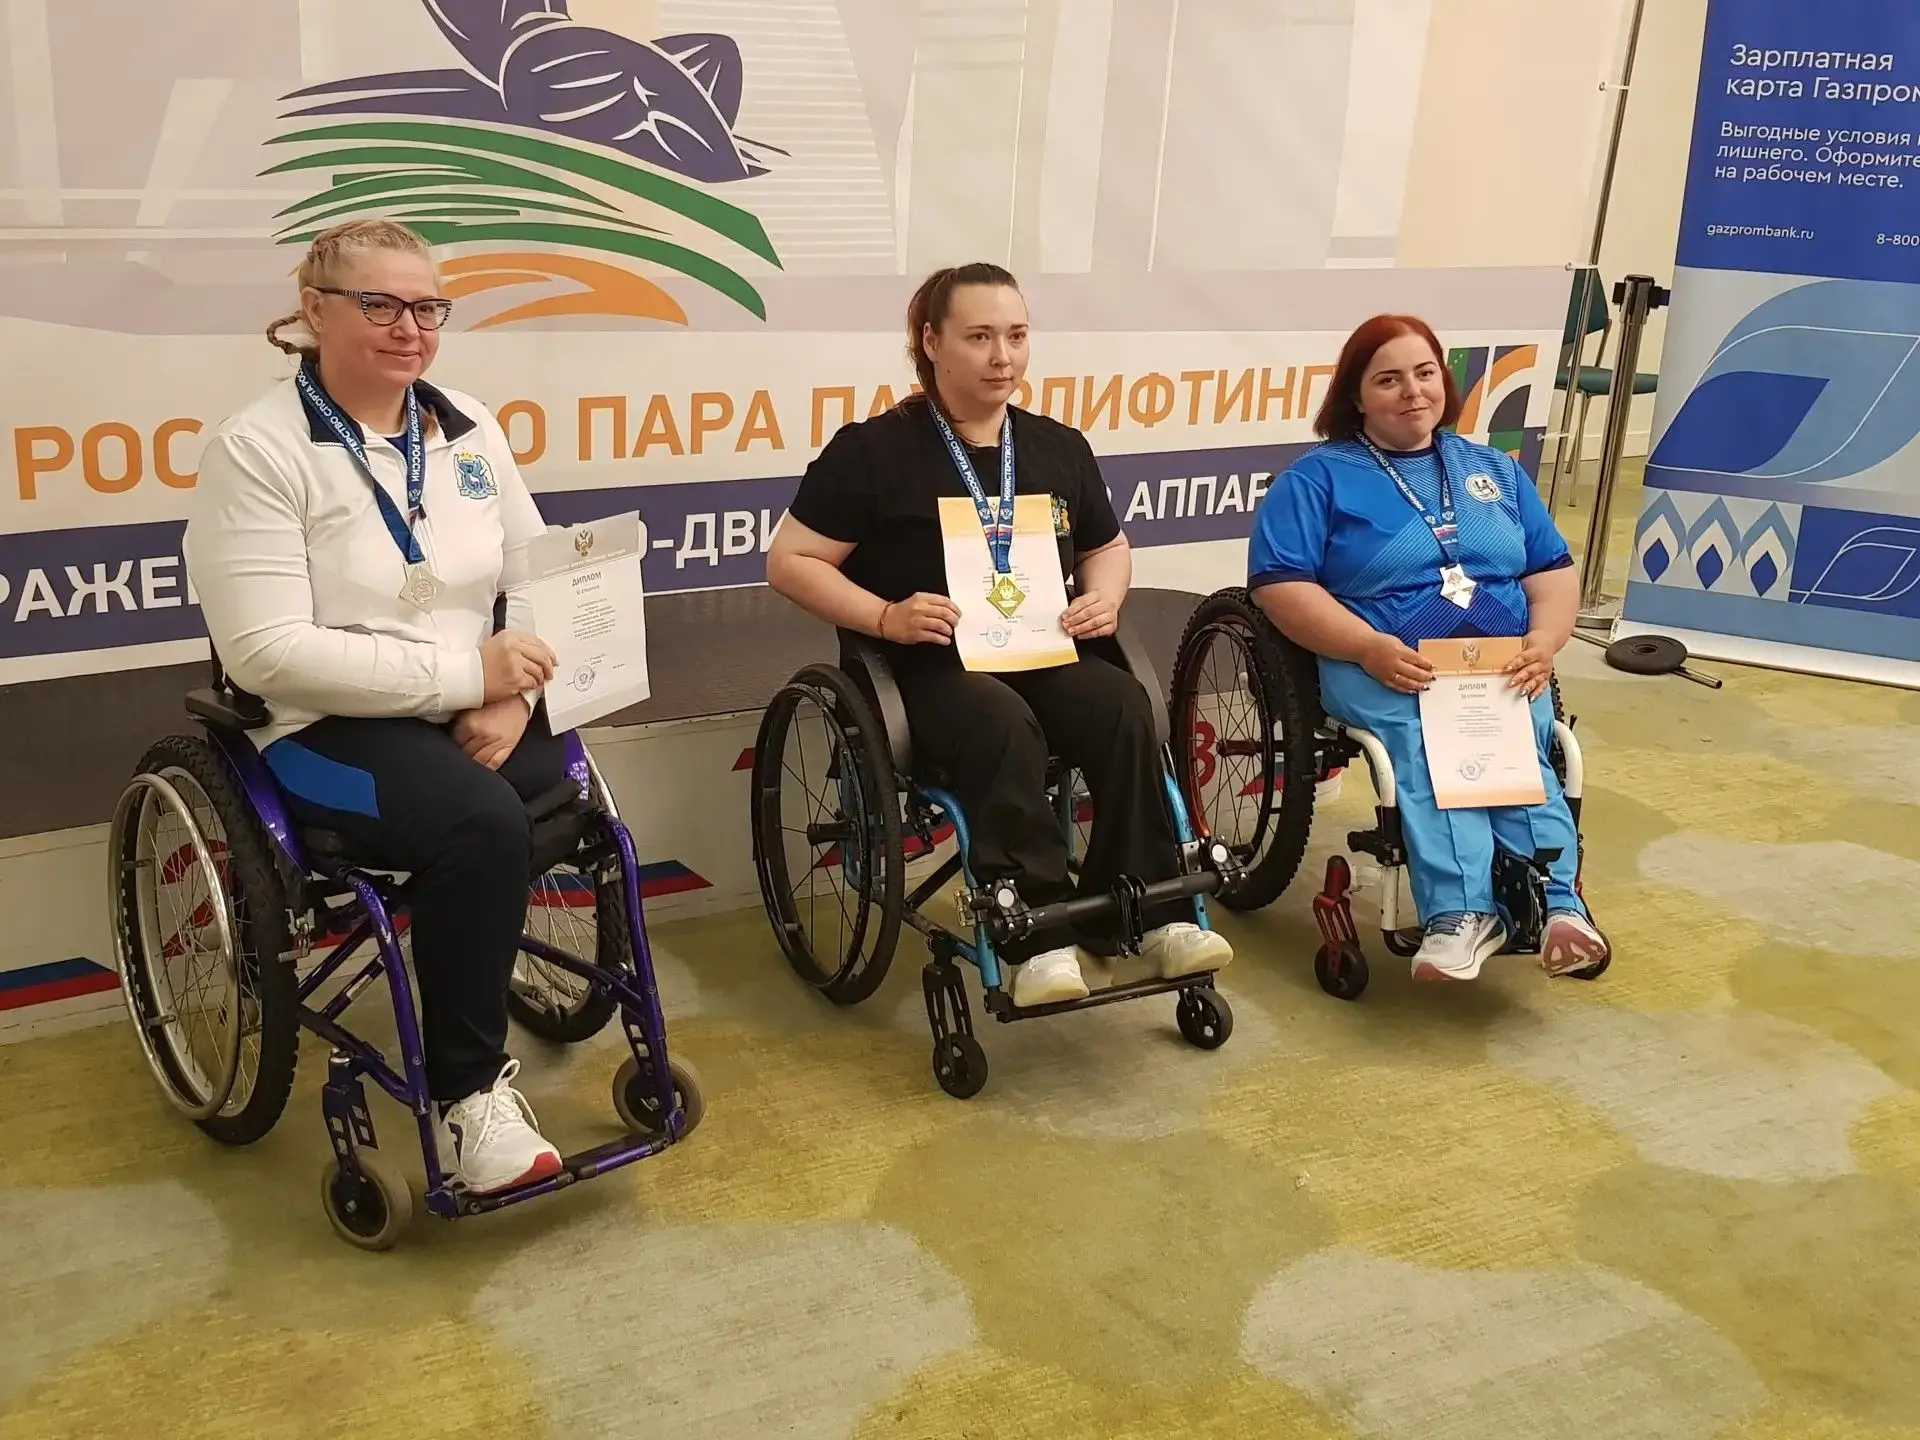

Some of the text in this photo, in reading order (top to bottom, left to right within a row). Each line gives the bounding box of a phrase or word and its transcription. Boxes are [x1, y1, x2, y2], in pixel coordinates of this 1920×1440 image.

[1730, 43, 1893, 72] Зарплатная
[1726, 77, 1803, 101] карта
[1720, 121, 1821, 142] Выгодные
[1827, 128, 1911, 146] условия
[1716, 145, 1920, 169] лишнего. Оформите
[1714, 164, 1904, 188] на рабочем месте.
[1706, 222, 1815, 240] gazprombank.ru
[306, 384, 332, 417] СПОРТА
[410, 411, 420, 442] СПОРТА
[14, 417, 203, 500] РОС
[496, 399, 546, 466] О
[578, 390, 785, 462] ПАРА
[412, 443, 421, 482] РОССИИ
[950, 440, 969, 471] СПОРТА
[963, 470, 985, 503] РОССИИ
[0, 556, 200, 623] АЖЕ
[1124, 472, 1272, 522] АППАР
[572, 571, 602, 587] ДИПЛОМ
[1458, 682, 1487, 691] ДИПЛОМ
